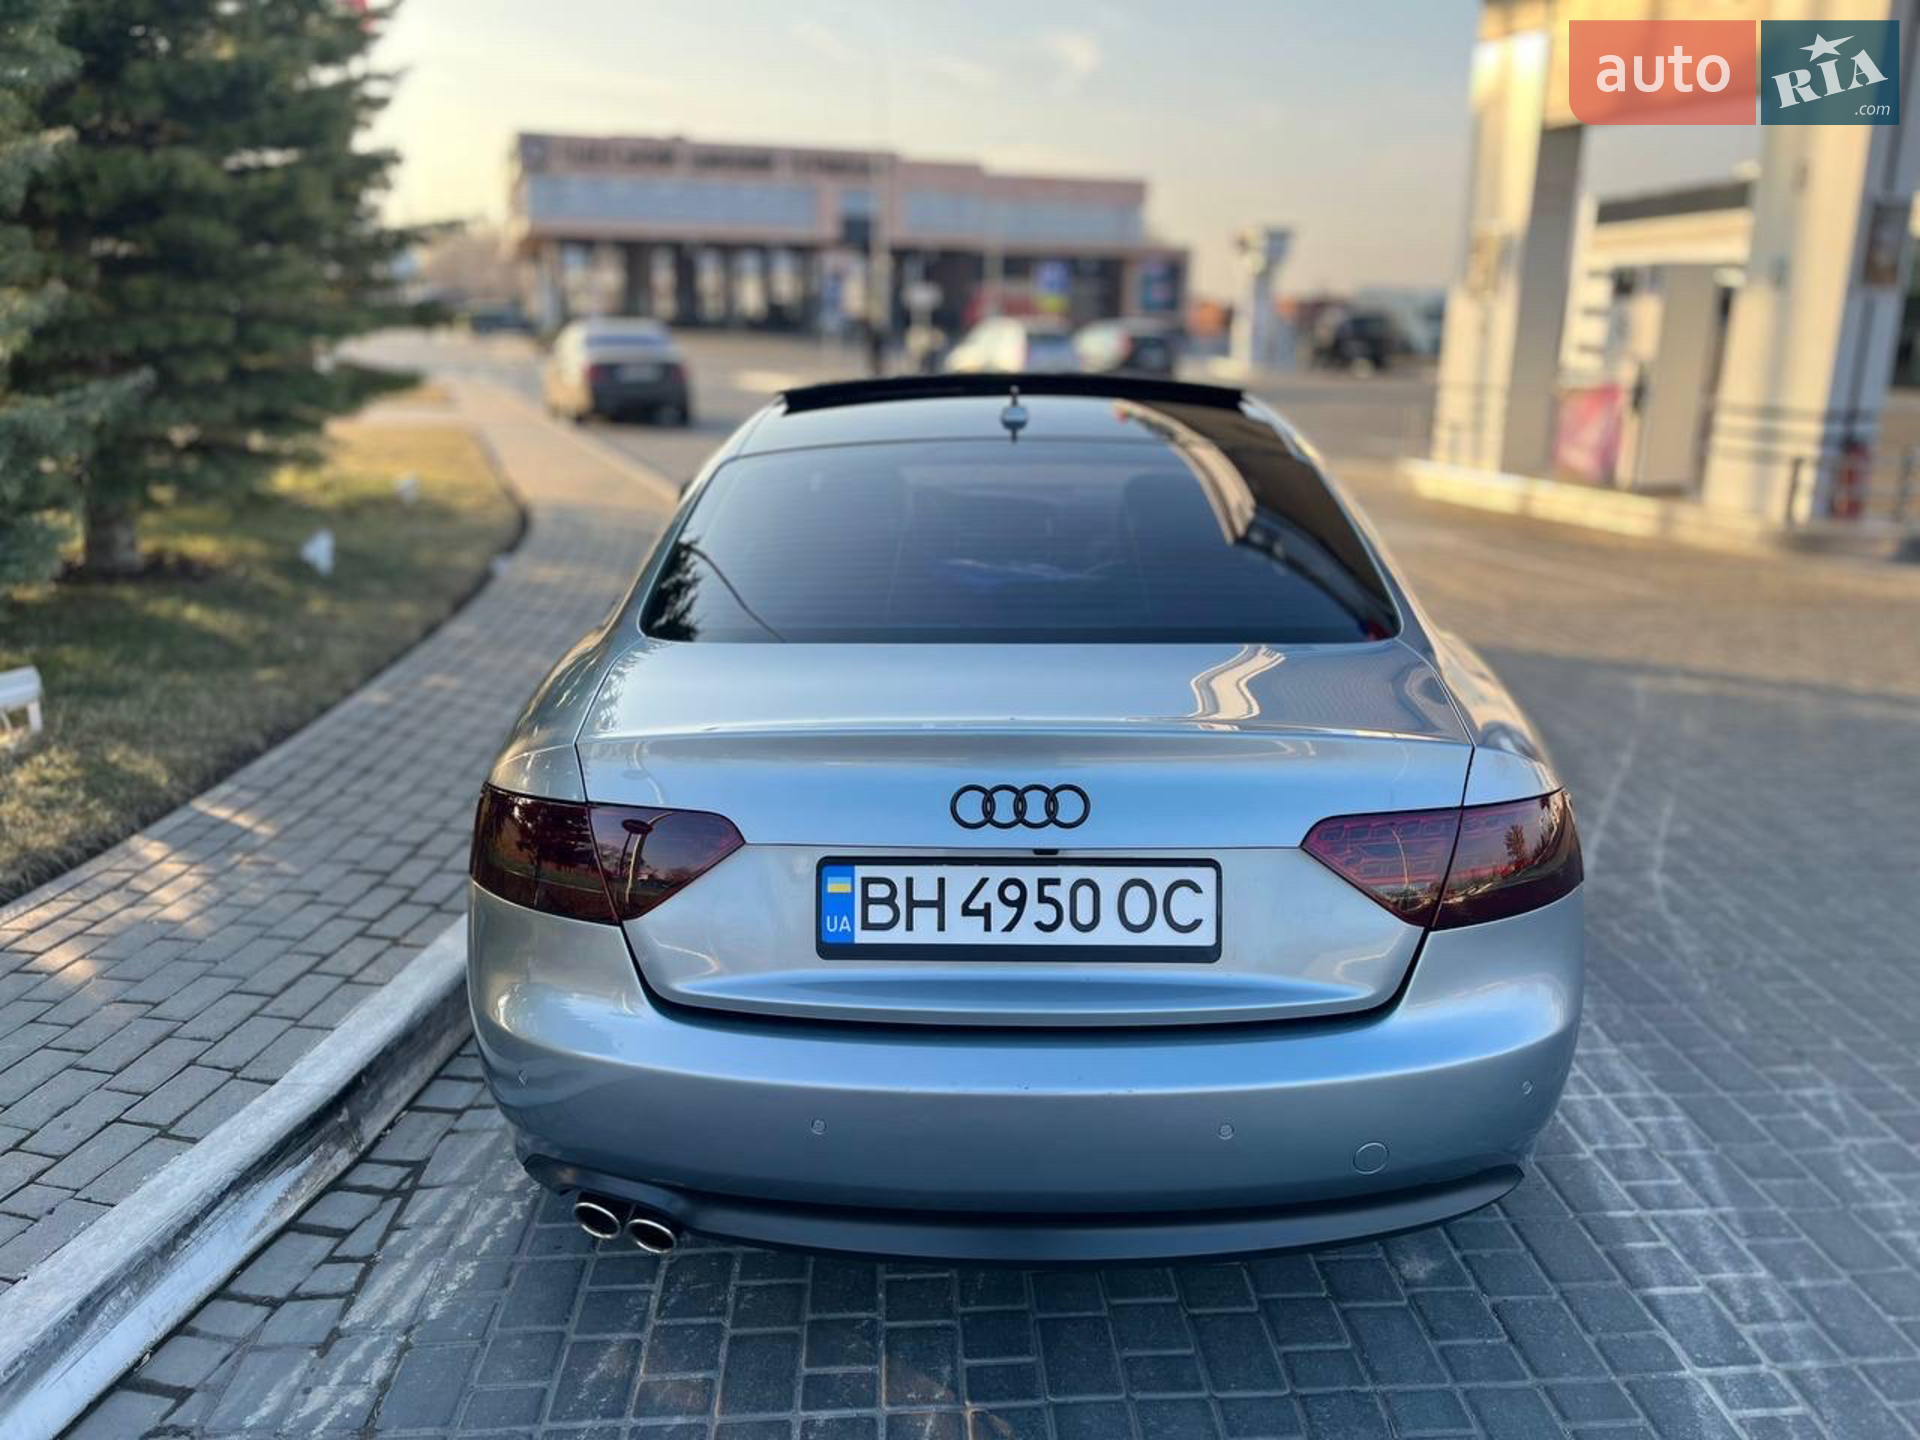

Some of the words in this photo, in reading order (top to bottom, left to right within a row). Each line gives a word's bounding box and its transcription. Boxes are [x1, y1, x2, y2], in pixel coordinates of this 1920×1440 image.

[860, 876, 946, 932] BH
[961, 877, 1101, 933] 4950
[1117, 878, 1204, 933] OC
[826, 915, 851, 932] UA
